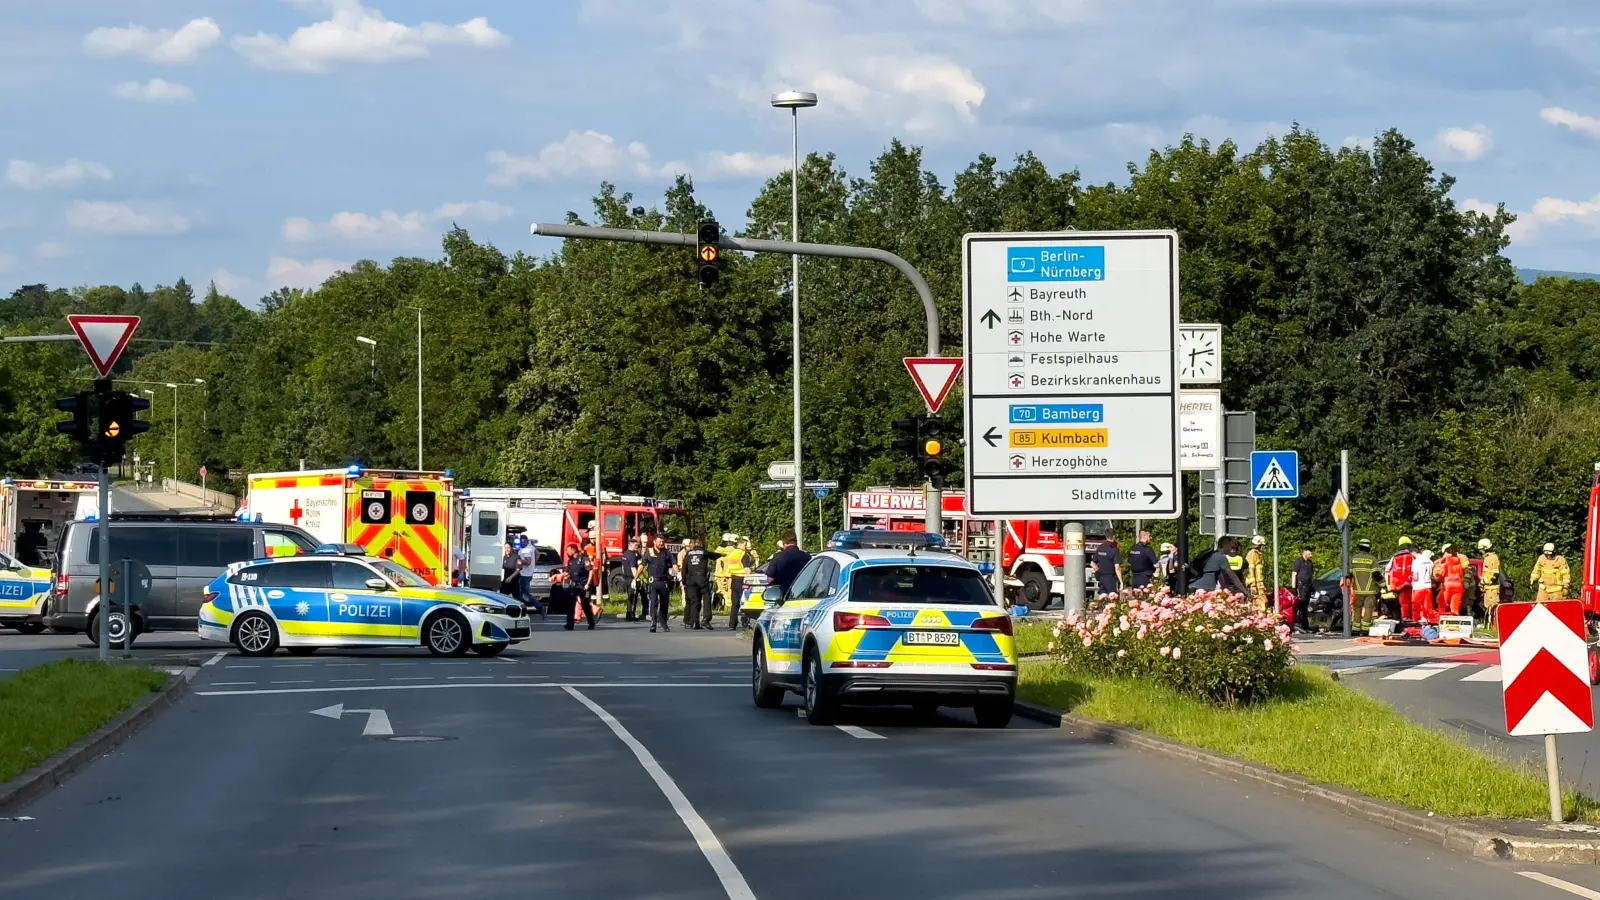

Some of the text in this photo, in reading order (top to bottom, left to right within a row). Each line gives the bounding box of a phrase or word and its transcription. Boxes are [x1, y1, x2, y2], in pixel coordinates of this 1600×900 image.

[1041, 250, 1085, 262] Berlin-
[1020, 260, 1102, 280] 9 Nürnberg
[1030, 288, 1087, 302] Bayreuth
[1030, 309, 1093, 321] Bth.-Nord
[1030, 331, 1106, 343] Hohe Warte
[1031, 353, 1119, 367] Festspielhaus
[1031, 374, 1161, 387] Bezirkskrankenhaus
[1179, 403, 1213, 411] HERTEL
[1019, 408, 1100, 422] 70 Bamberg
[1019, 432, 1105, 444] 85 Kulmbach
[1032, 455, 1108, 470] Herzoghöhe
[851, 494, 927, 509] FEUERWE
[1072, 489, 1137, 501] Stadtmitte
[0, 584, 24, 597] IZEI
[339, 603, 391, 618] POLIZEI
[908, 632, 957, 643] BT P 8592
